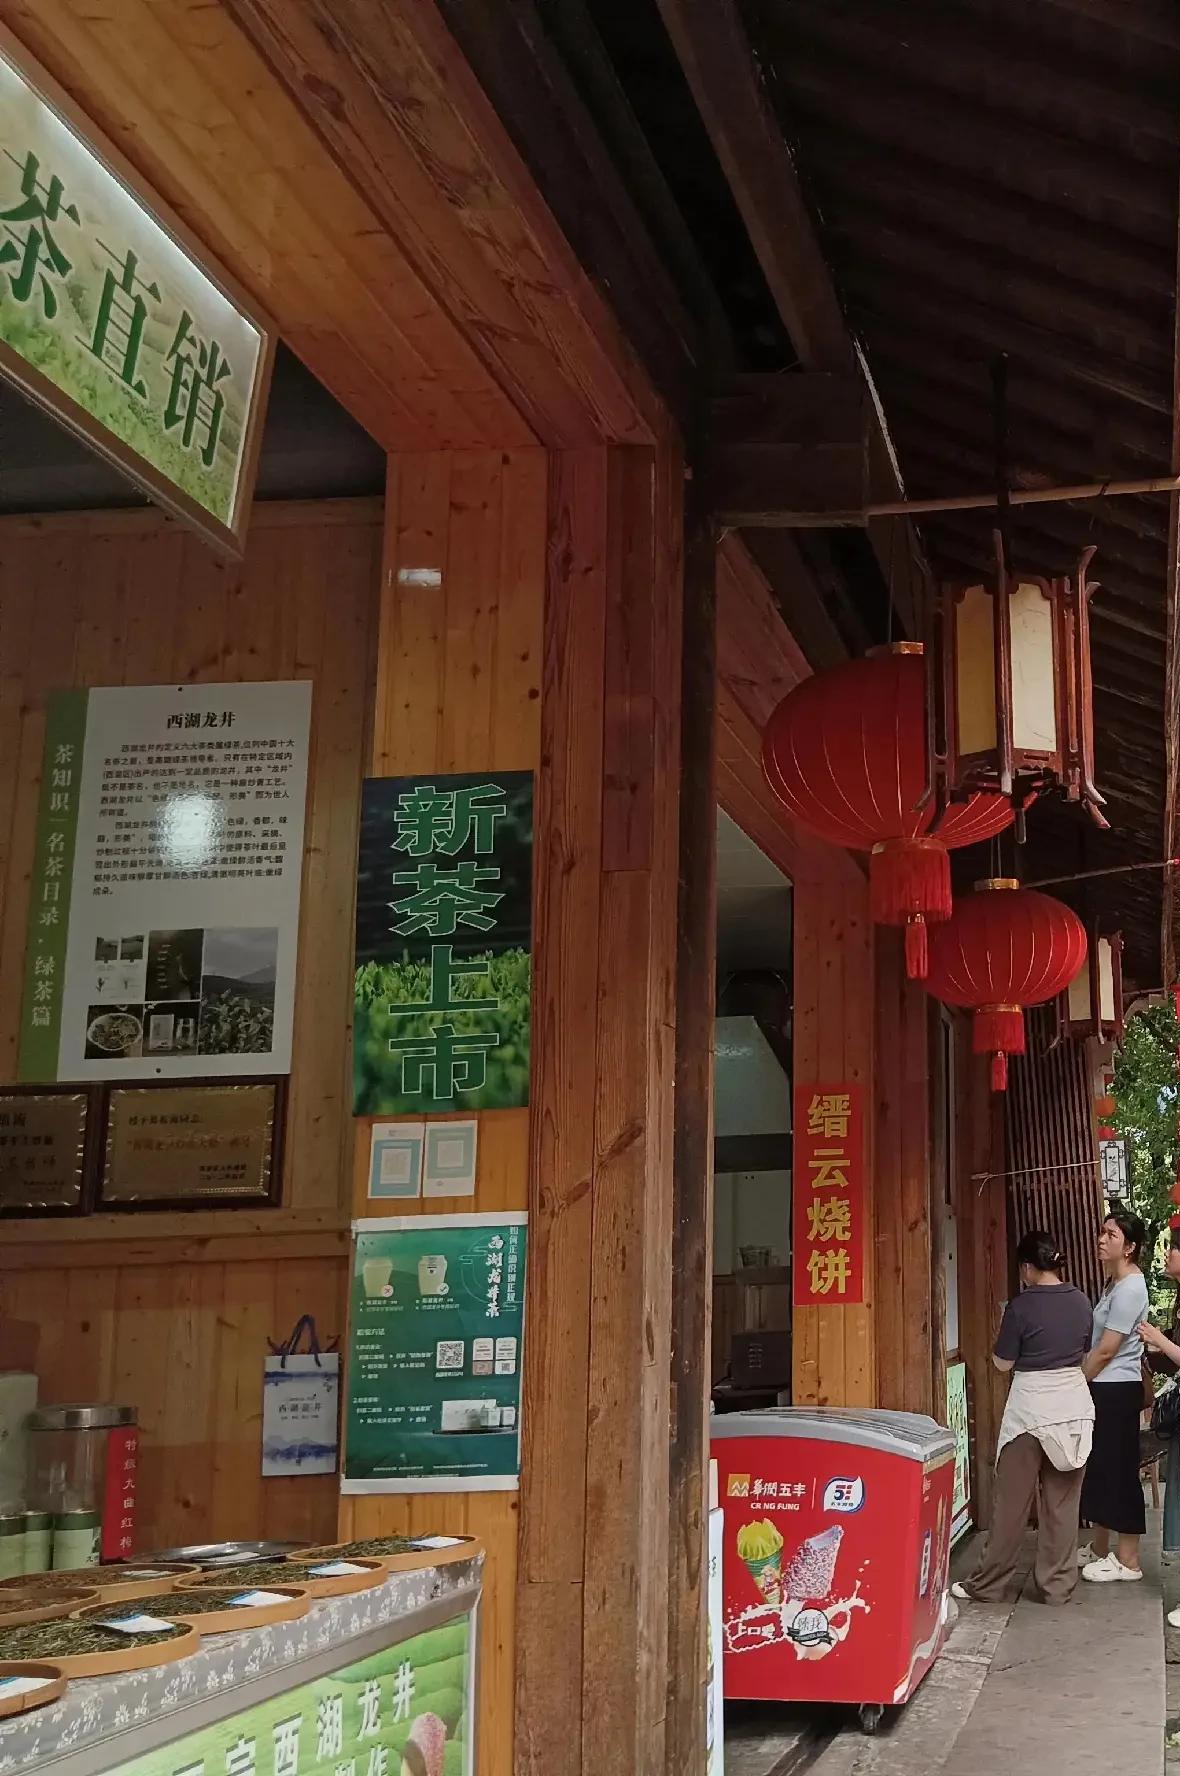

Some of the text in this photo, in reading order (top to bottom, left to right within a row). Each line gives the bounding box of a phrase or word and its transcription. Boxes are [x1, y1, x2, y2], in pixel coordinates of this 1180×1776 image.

[166, 711, 237, 729] 西湖龙井
[387, 783, 507, 1100] 新茶上市
[806, 1092, 853, 1295] 缙云烧饼
